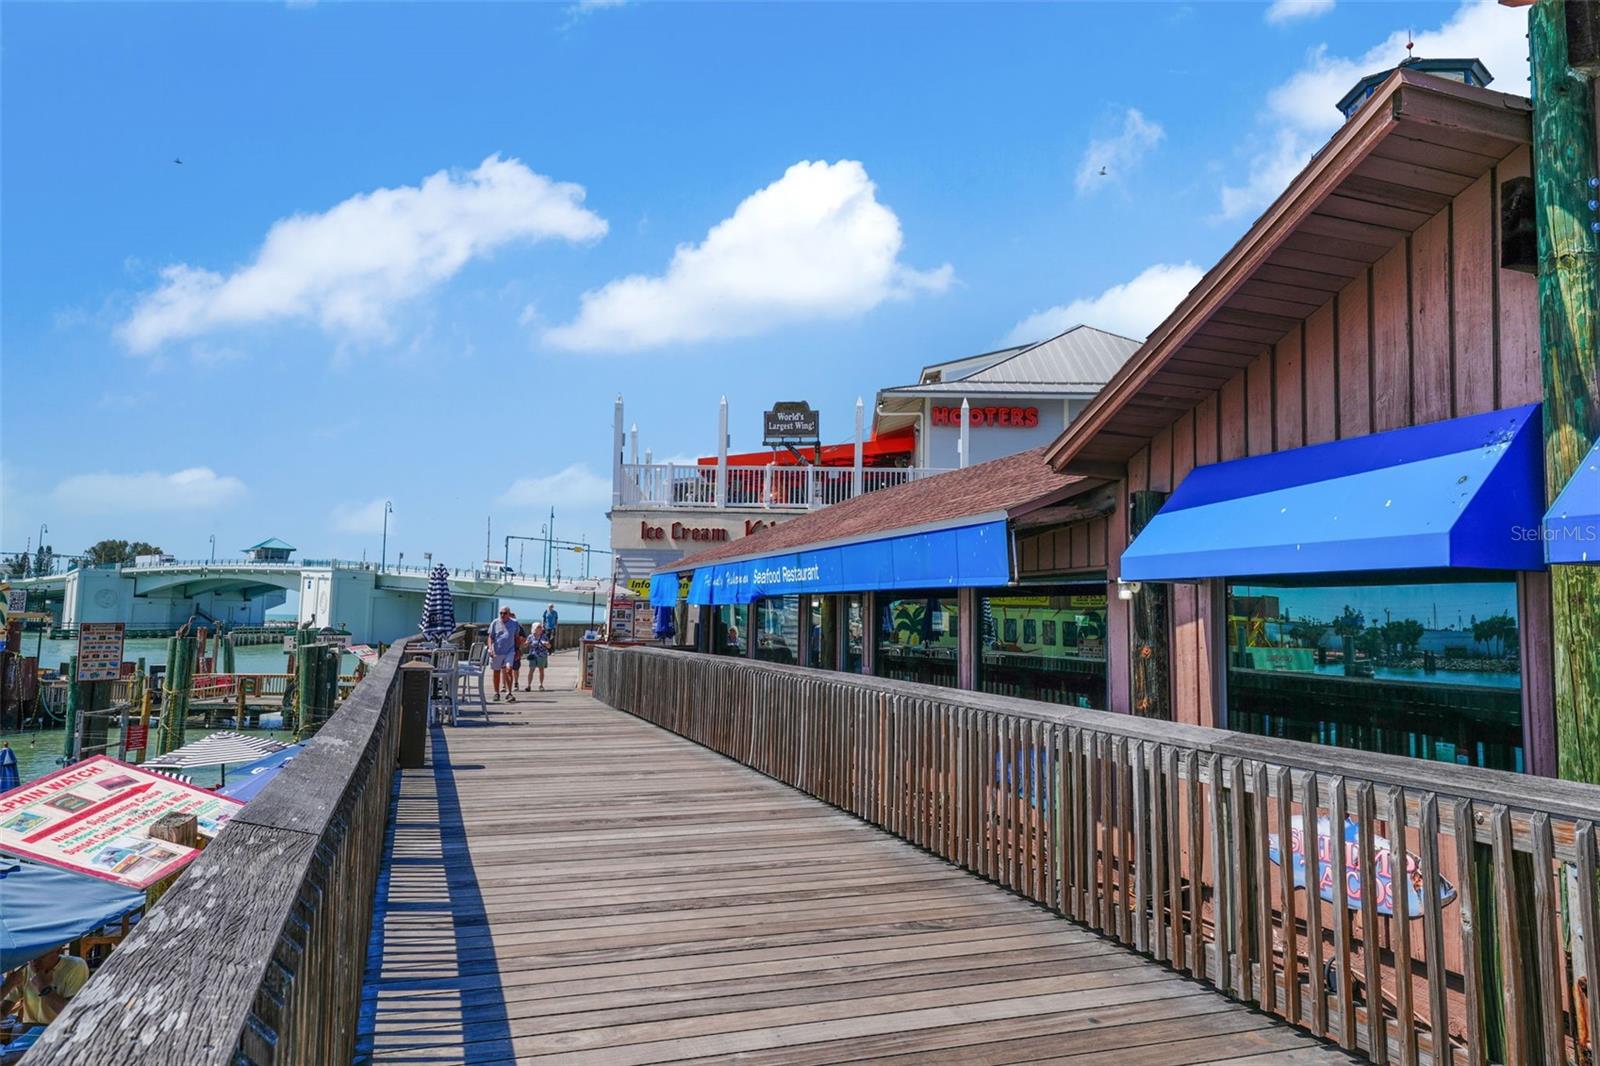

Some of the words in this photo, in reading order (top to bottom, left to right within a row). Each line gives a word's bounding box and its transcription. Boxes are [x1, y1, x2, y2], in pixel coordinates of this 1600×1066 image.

[768, 422, 793, 431] Largest
[795, 421, 815, 431] Wing!
[777, 412, 804, 421] World's
[932, 406, 1039, 427] HOOTERS
[641, 521, 664, 540] Ice
[671, 522, 727, 541] Cream
[753, 568, 780, 584] Seafood
[782, 563, 820, 583] Restaurant
[46, 766, 103, 790] WATCH
[1300, 855, 1398, 909] ACOS
